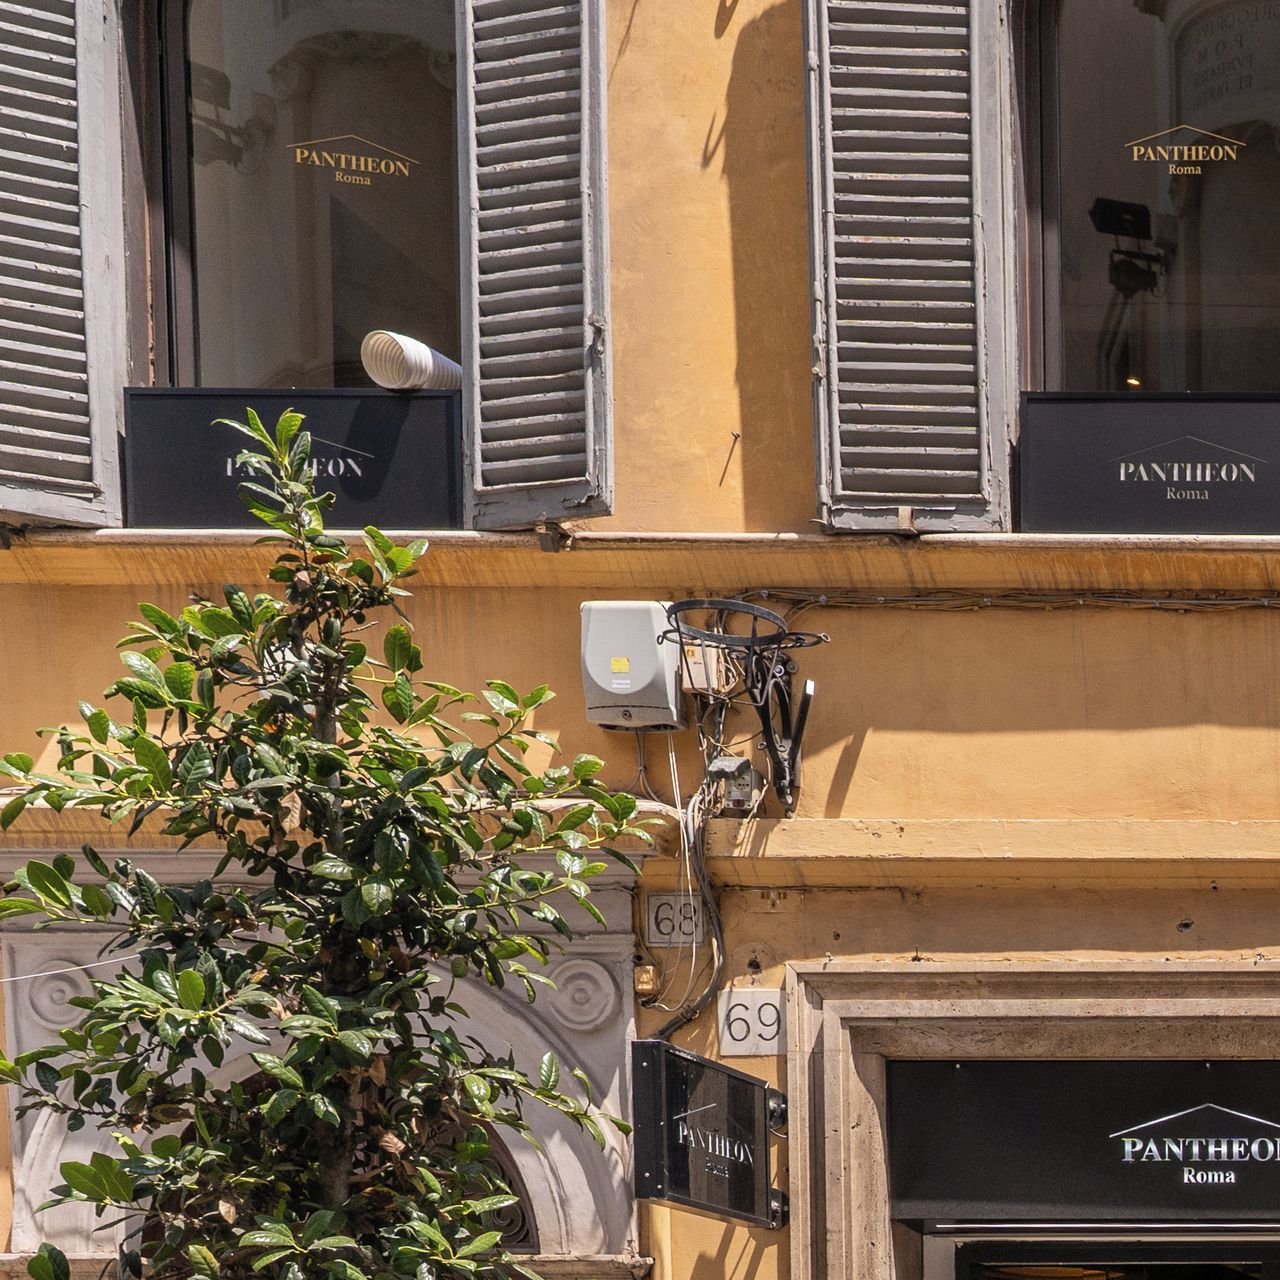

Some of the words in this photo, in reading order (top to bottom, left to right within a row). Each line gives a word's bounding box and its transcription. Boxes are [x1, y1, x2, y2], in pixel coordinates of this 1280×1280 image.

[294, 146, 411, 178] PANTHEON
[1131, 144, 1238, 162] PANTHEON
[334, 170, 372, 186] Roma
[1167, 163, 1202, 175] Roma
[1119, 462, 1256, 482] PANTHEON
[1166, 487, 1209, 500] Roma
[654, 902, 699, 936] 68
[727, 1002, 782, 1042] 69
[677, 1120, 755, 1166] PANTHEON
[1183, 1167, 1236, 1184] Roma
